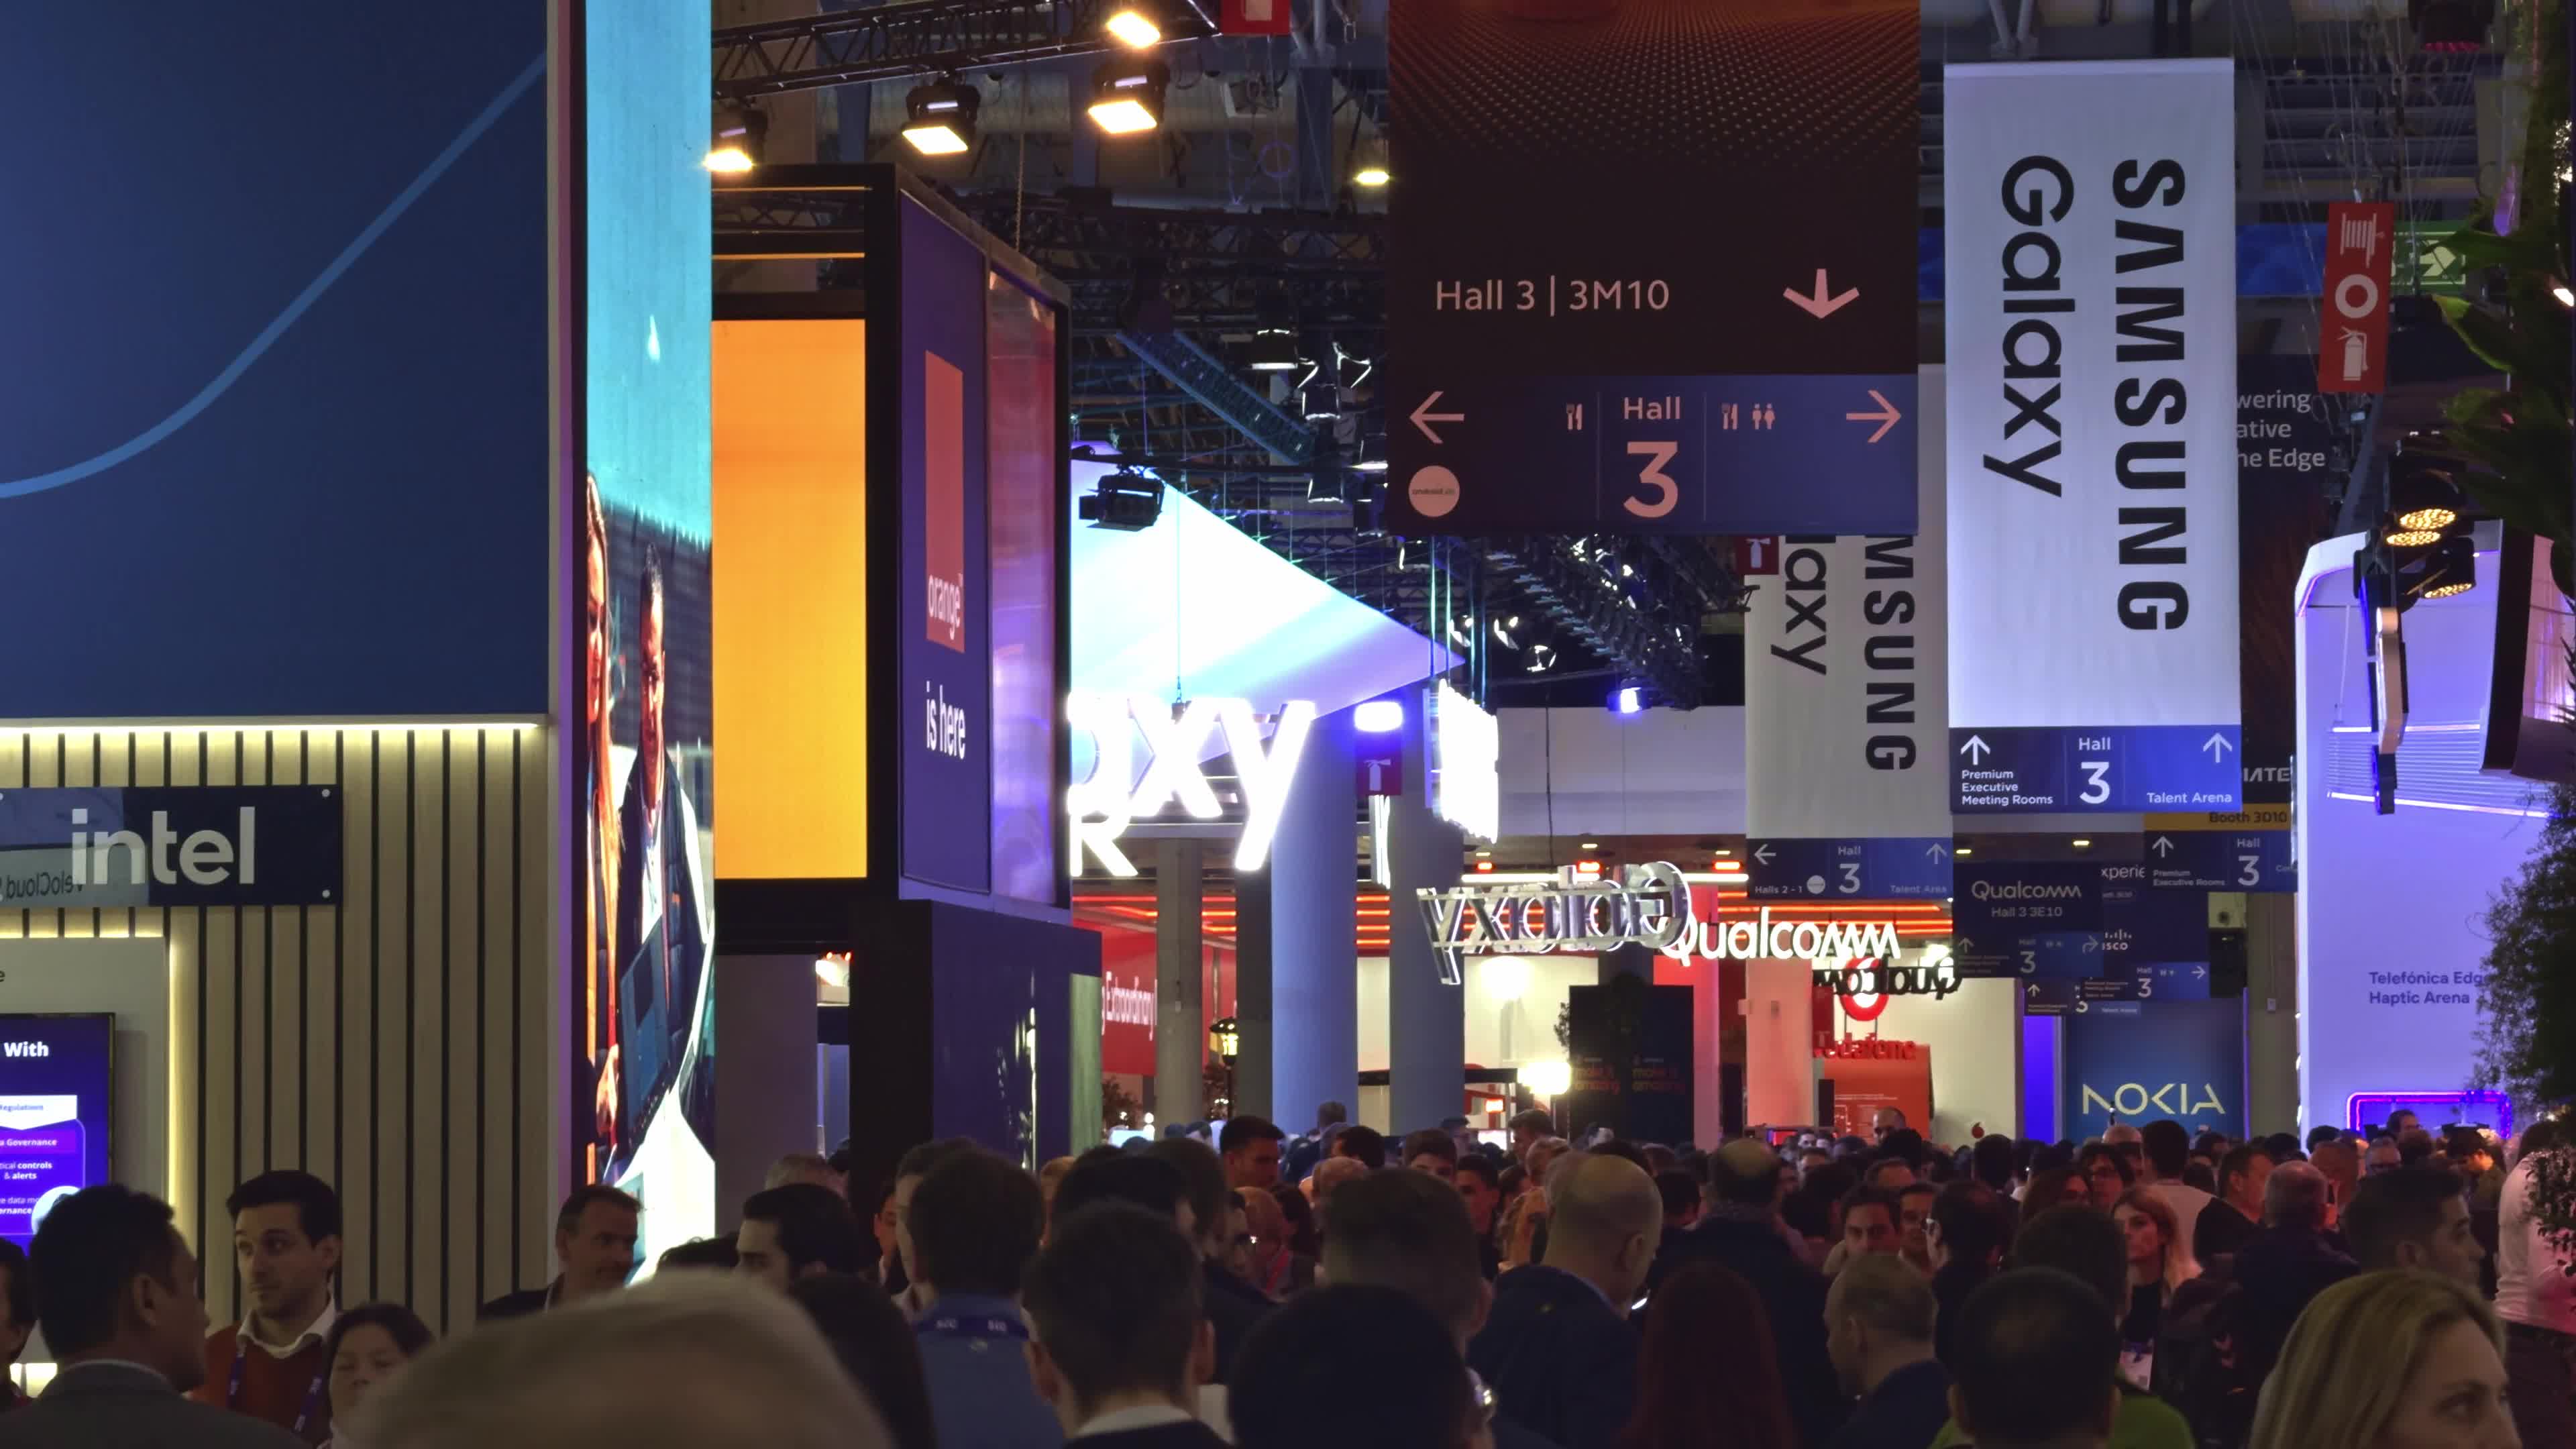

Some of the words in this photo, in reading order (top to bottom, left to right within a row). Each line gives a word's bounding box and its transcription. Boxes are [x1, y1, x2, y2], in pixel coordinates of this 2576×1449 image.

[1436, 280, 1503, 310] Hall
[1517, 281, 1535, 309] 3
[1569, 280, 1669, 310] 3M10
[1983, 155, 2076, 498] Galaxy
[2112, 158, 2190, 631] SAMSUNG
[2237, 390, 2312, 413] wering
[1624, 397, 1681, 420] Hall
[2237, 419, 2292, 438] ative
[2238, 451, 2263, 468] he
[2269, 448, 2326, 472] Edge
[1623, 441, 1679, 518] 3
[928, 574, 961, 640] orange
[1771, 535, 1837, 675] laxy
[1864, 535, 1917, 770] MSUNG
[926, 681, 936, 751] is
[940, 684, 965, 759] here
[2079, 737, 2111, 751] Hall
[1962, 769, 2013, 779] Premium
[2080, 761, 2110, 804] 3
[1962, 782, 2018, 792] Executive
[2147, 792, 2187, 803] Talent
[2192, 792, 2233, 803] Arena
[1962, 795, 2009, 806] Meeting
[2013, 794, 2053, 805] Rooms
[2209, 811, 2249, 823] Booth
[72, 806, 256, 885] intel
[1838, 846, 1861, 855] Hall
[2237, 839, 2260, 848] Hall
[1839, 863, 1860, 894] 3
[2238, 855, 2259, 886] 3
[1971, 880, 2082, 901] Qualcomm
[1991, 907, 2015, 917] Hall
[2019, 907, 2027, 916] 3
[2029, 907, 2063, 917] 3E10
[1656, 906, 1900, 967] Qualcomm
[2020, 951, 2036, 973] 3
[2138, 978, 2152, 998] 3
[2369, 971, 2449, 984] Telefónica
[2369, 991, 2418, 1006] Haptic
[2424, 992, 2470, 1004] Arena
[4, 1041, 49, 1057] With
[2082, 1083, 2226, 1116] NOKIA
[17, 1161, 52, 1169] controls
